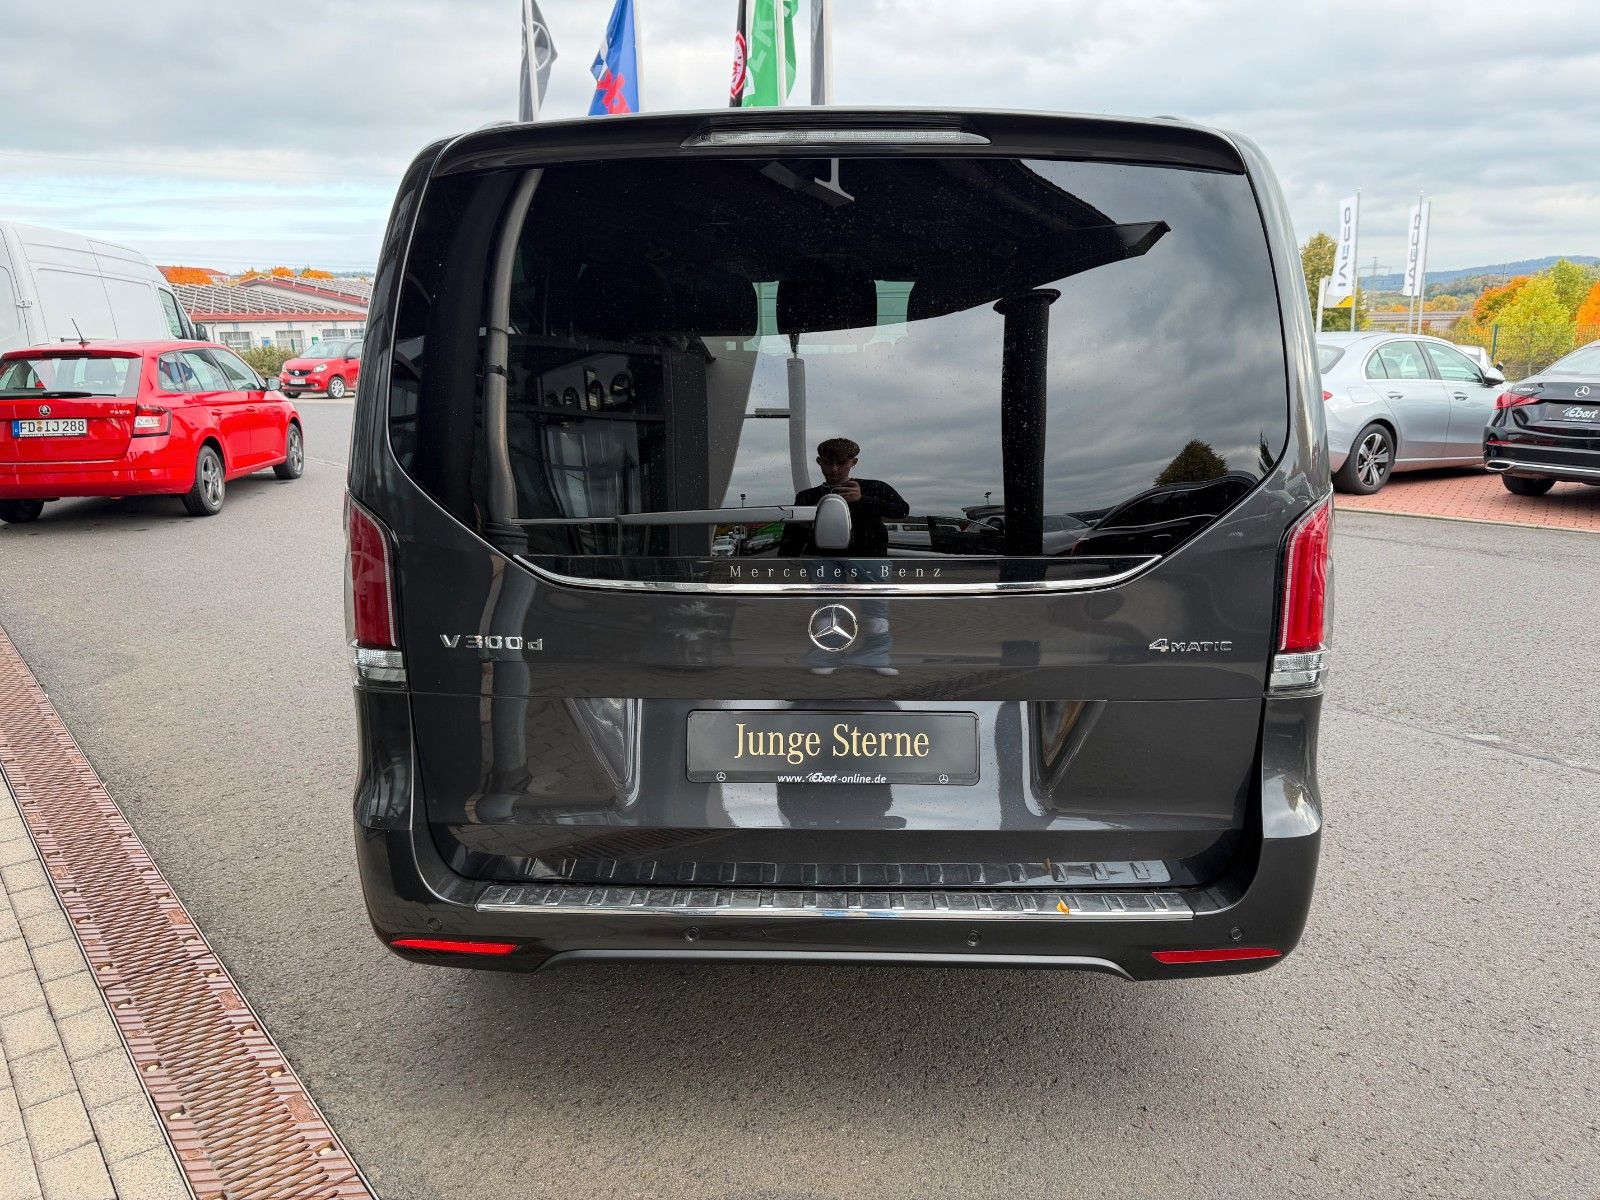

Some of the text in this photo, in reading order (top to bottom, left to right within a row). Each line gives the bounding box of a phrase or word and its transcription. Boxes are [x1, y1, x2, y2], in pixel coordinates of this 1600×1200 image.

[1568, 407, 1599, 419] Ebert
[20, 421, 36, 433] FD
[62, 420, 85, 432] 288
[729, 565, 941, 578] Mercedes-Benz
[1148, 638, 1233, 653] 4MATIC
[734, 723, 930, 765] Junge Sterne
